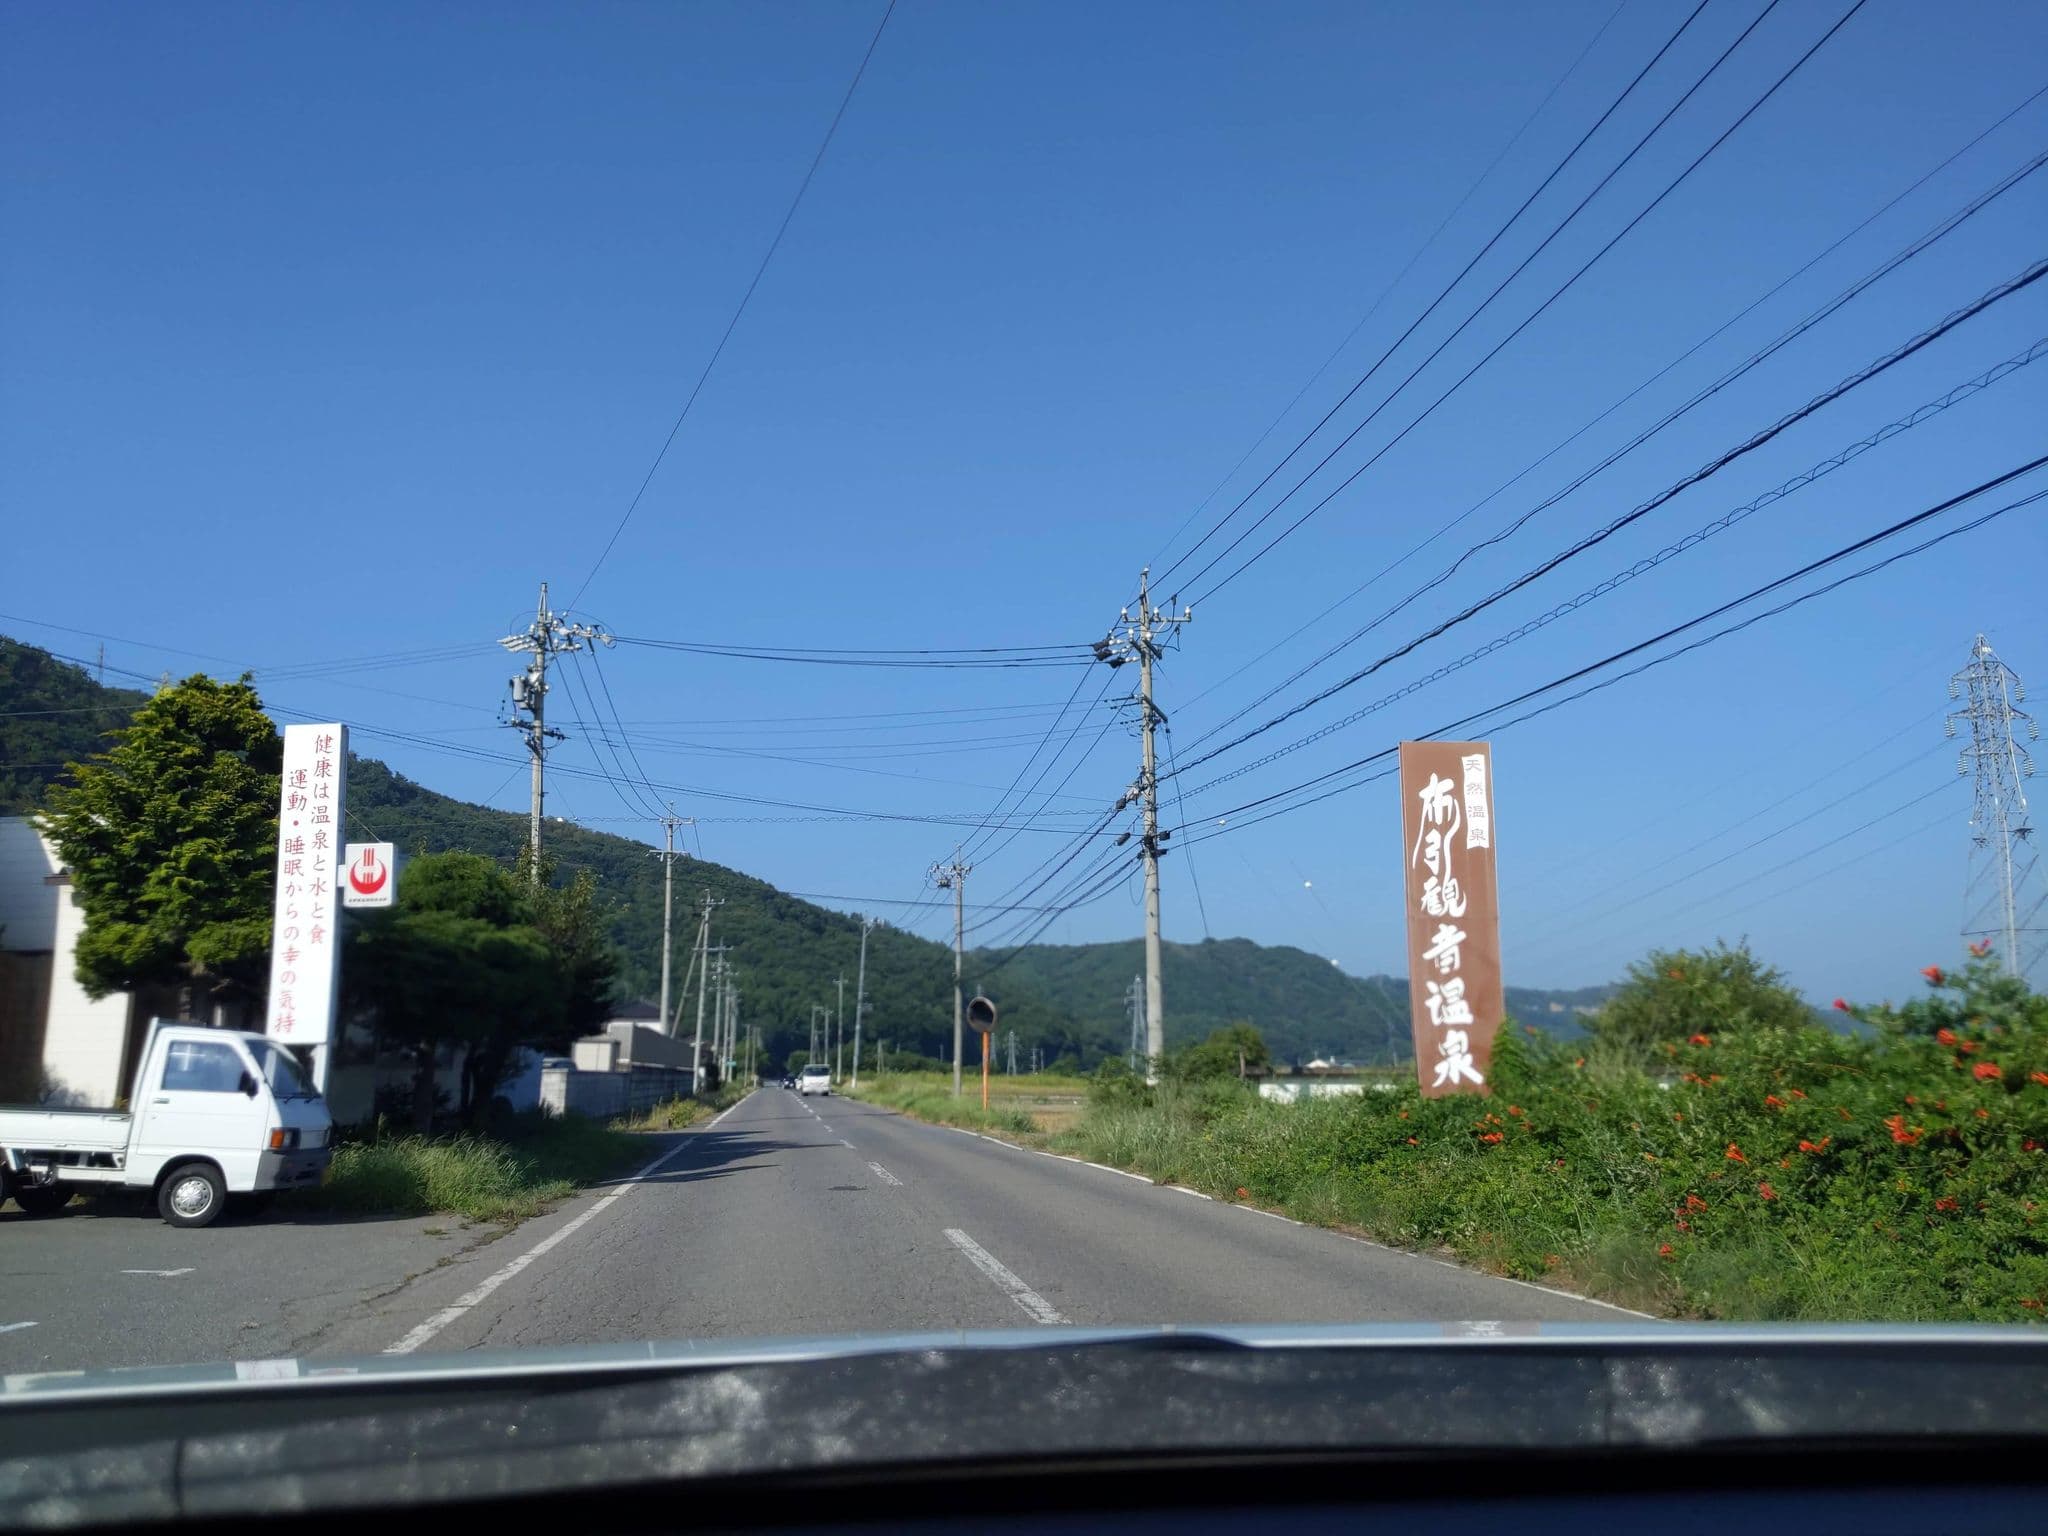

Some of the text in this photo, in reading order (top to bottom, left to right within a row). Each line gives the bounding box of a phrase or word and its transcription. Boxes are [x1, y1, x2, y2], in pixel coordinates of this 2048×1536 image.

[274, 768, 309, 1034] 運動・睡眠からの幸の気持
[308, 733, 334, 944] 健康は温泉と水と食
[1465, 759, 1486, 843] 天然温泉
[1412, 772, 1485, 1090] 布引観音温泉
